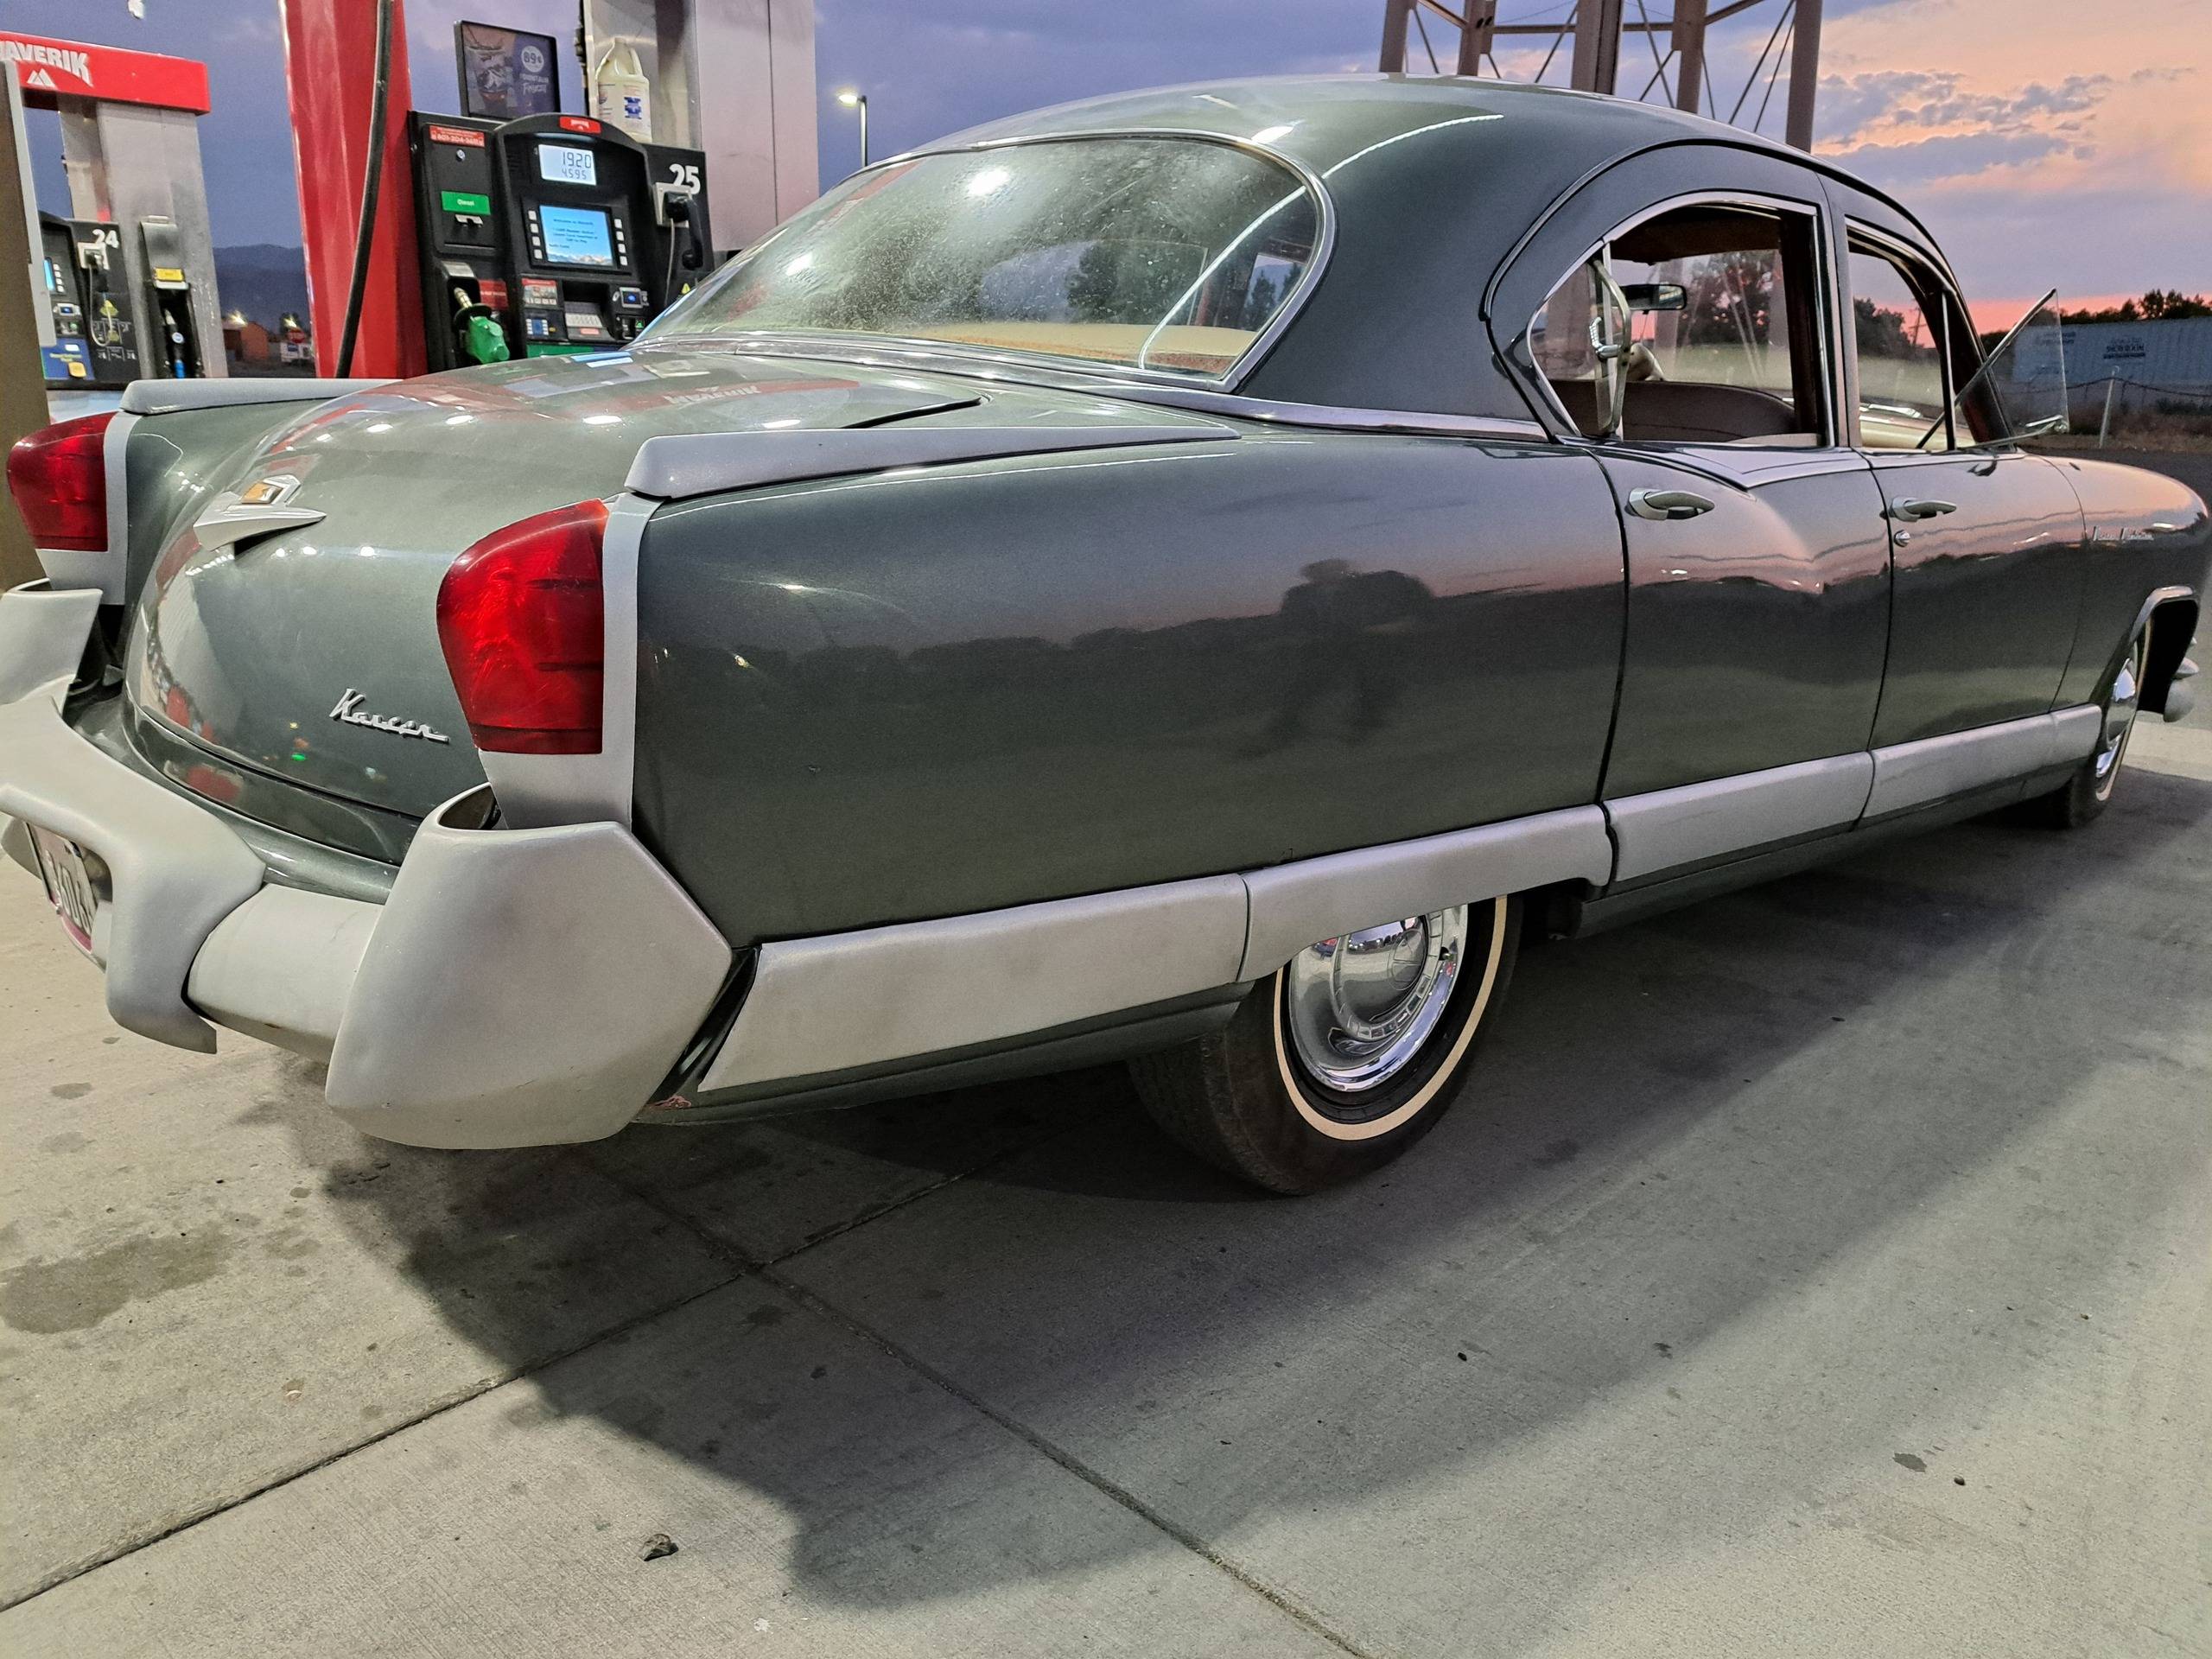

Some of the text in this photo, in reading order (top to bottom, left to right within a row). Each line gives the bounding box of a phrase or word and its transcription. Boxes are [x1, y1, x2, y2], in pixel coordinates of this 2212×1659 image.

[562, 151, 592, 169] 1920
[669, 163, 701, 194] 25
[92, 228, 119, 249] 24
